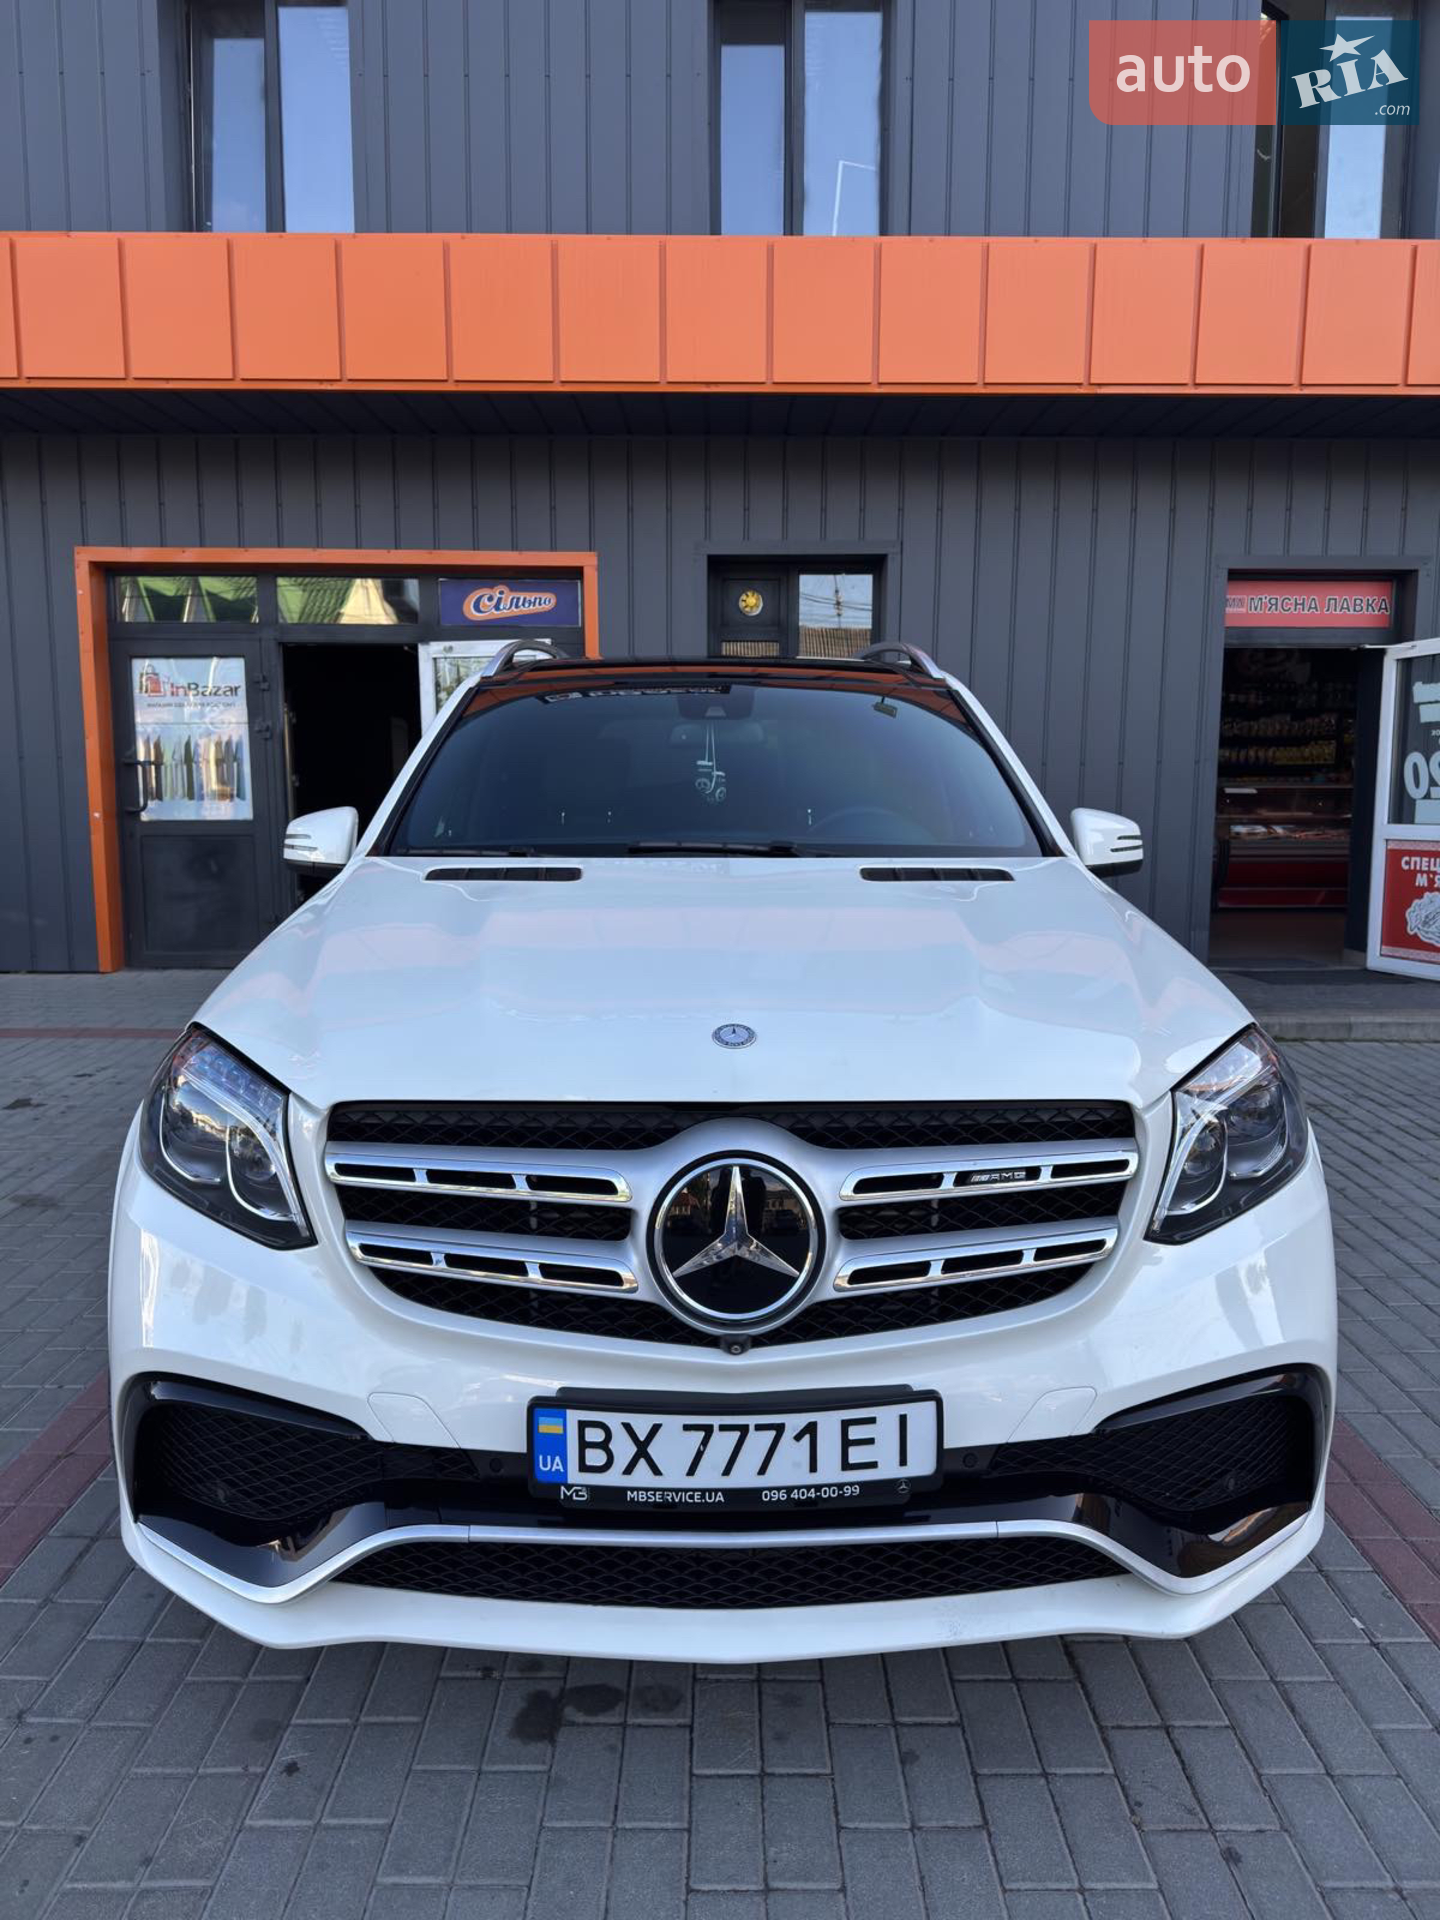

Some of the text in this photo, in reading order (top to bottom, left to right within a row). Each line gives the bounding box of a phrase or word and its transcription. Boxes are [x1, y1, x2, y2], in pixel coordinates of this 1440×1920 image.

[471, 589, 553, 616] Сільпо
[1248, 595, 1320, 614] М'ЯСНА
[1324, 595, 1391, 614] ЛАВКА
[577, 1413, 908, 1477] BX 7771 EI
[539, 1455, 564, 1473] UA
[626, 1490, 725, 1503] MBSERVICE.UA
[761, 1484, 860, 1501] 096 404-00-99
